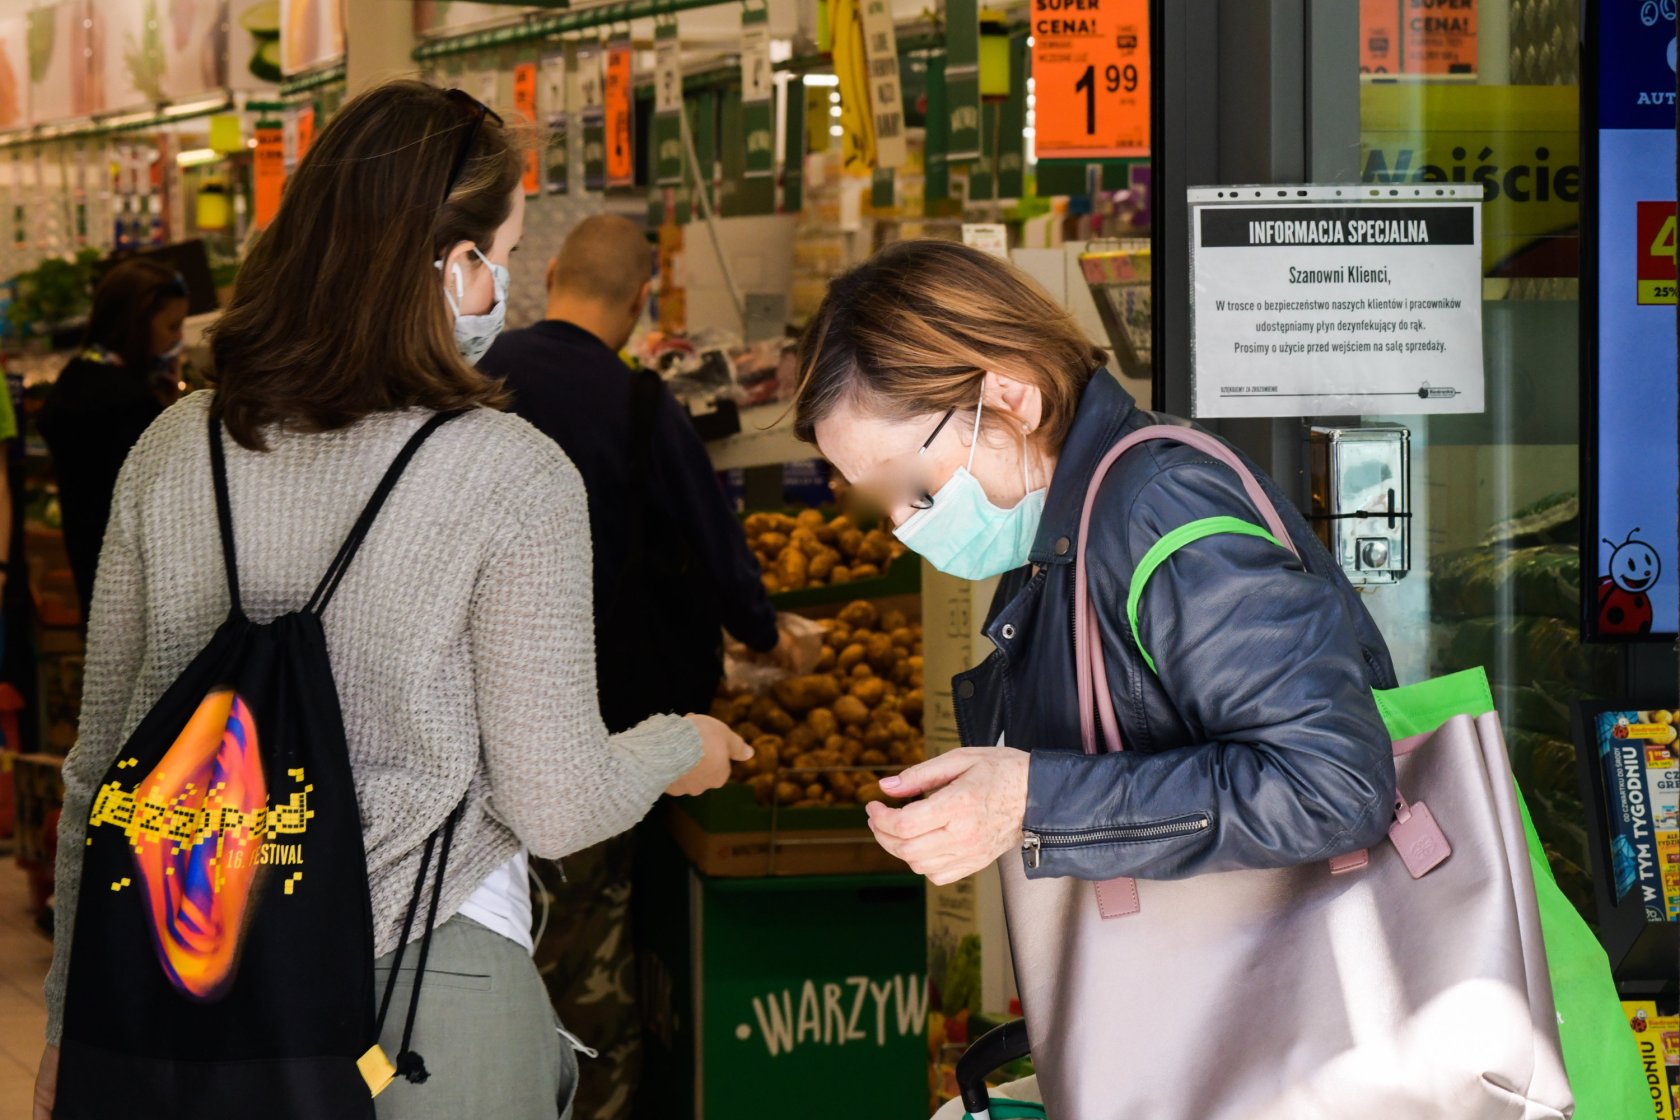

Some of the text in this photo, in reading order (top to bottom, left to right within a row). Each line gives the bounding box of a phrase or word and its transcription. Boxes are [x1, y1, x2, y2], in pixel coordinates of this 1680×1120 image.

[1037, 0, 1099, 10] SUPER
[1037, 19, 1096, 34] CENA!
[1410, 17, 1468, 32] CENA!
[1075, 64, 1138, 135] 1 99
[1249, 219, 1429, 244] INFORMACJA SPECJALNA
[1650, 215, 1677, 265] 4
[1289, 265, 1391, 285] Szanowni Klienci,
[1216, 297, 1462, 312] W trosce o bezpieczeństwo naszych klientów i pracowników
[1255, 319, 1426, 334] udostępniamy płyn dezynfekujący do rąk.
[1234, 340, 1447, 356] Prosimy o użycie przed wejściem na salę sprzedaży.
[1622, 747, 1649, 838] TYGODNIU
[226, 849, 245, 869] 16.
[1636, 844, 1655, 880] TYM
[1642, 885, 1657, 902] W
[753, 974, 928, 1057] WARZYW
